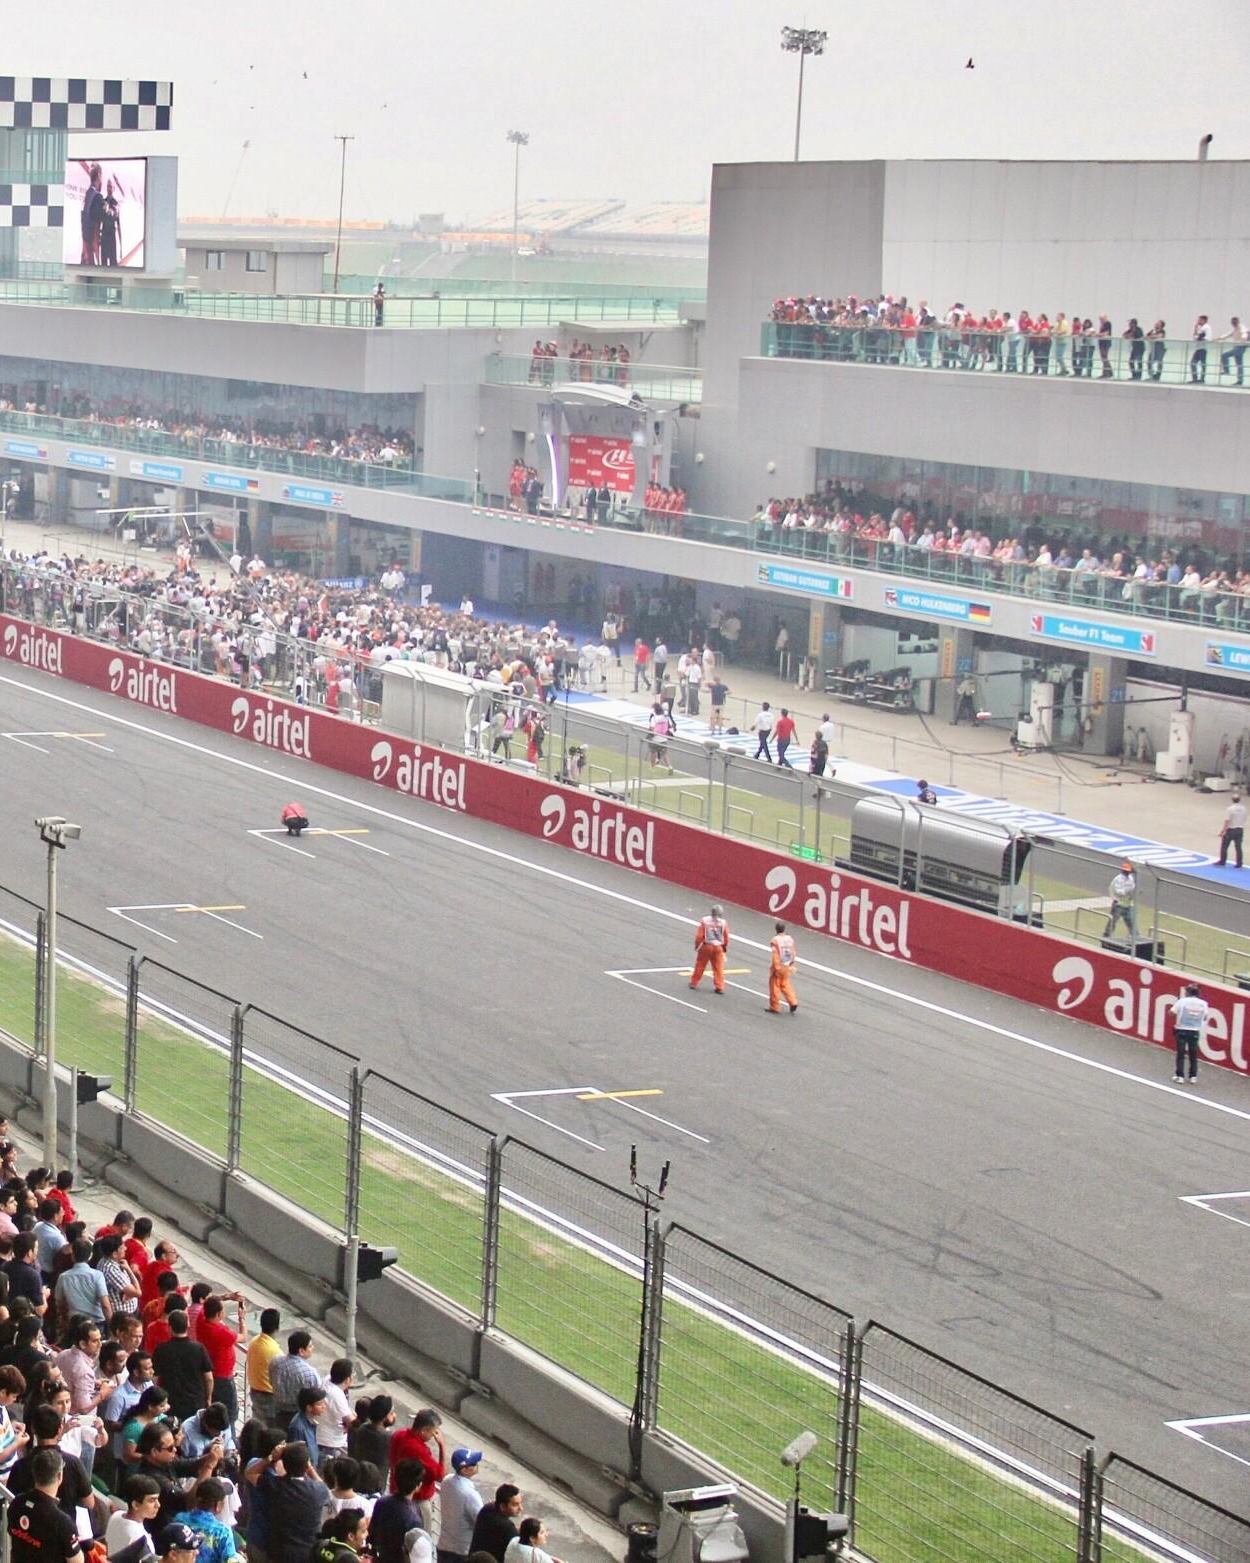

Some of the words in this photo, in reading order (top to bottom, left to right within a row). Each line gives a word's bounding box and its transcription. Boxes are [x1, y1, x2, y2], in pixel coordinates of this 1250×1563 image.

[902, 593, 920, 606] NICO
[20, 626, 63, 674] airtel
[1058, 622, 1088, 638] Sauber
[1089, 628, 1099, 640] F1
[1101, 630, 1125, 644] Team
[127, 659, 177, 713] airtel
[253, 700, 311, 759] airtel
[396, 744, 466, 811] airtel
[571, 802, 656, 873] airtel
[804, 874, 911, 959] airtel
[1104, 967, 1248, 1069] airel
